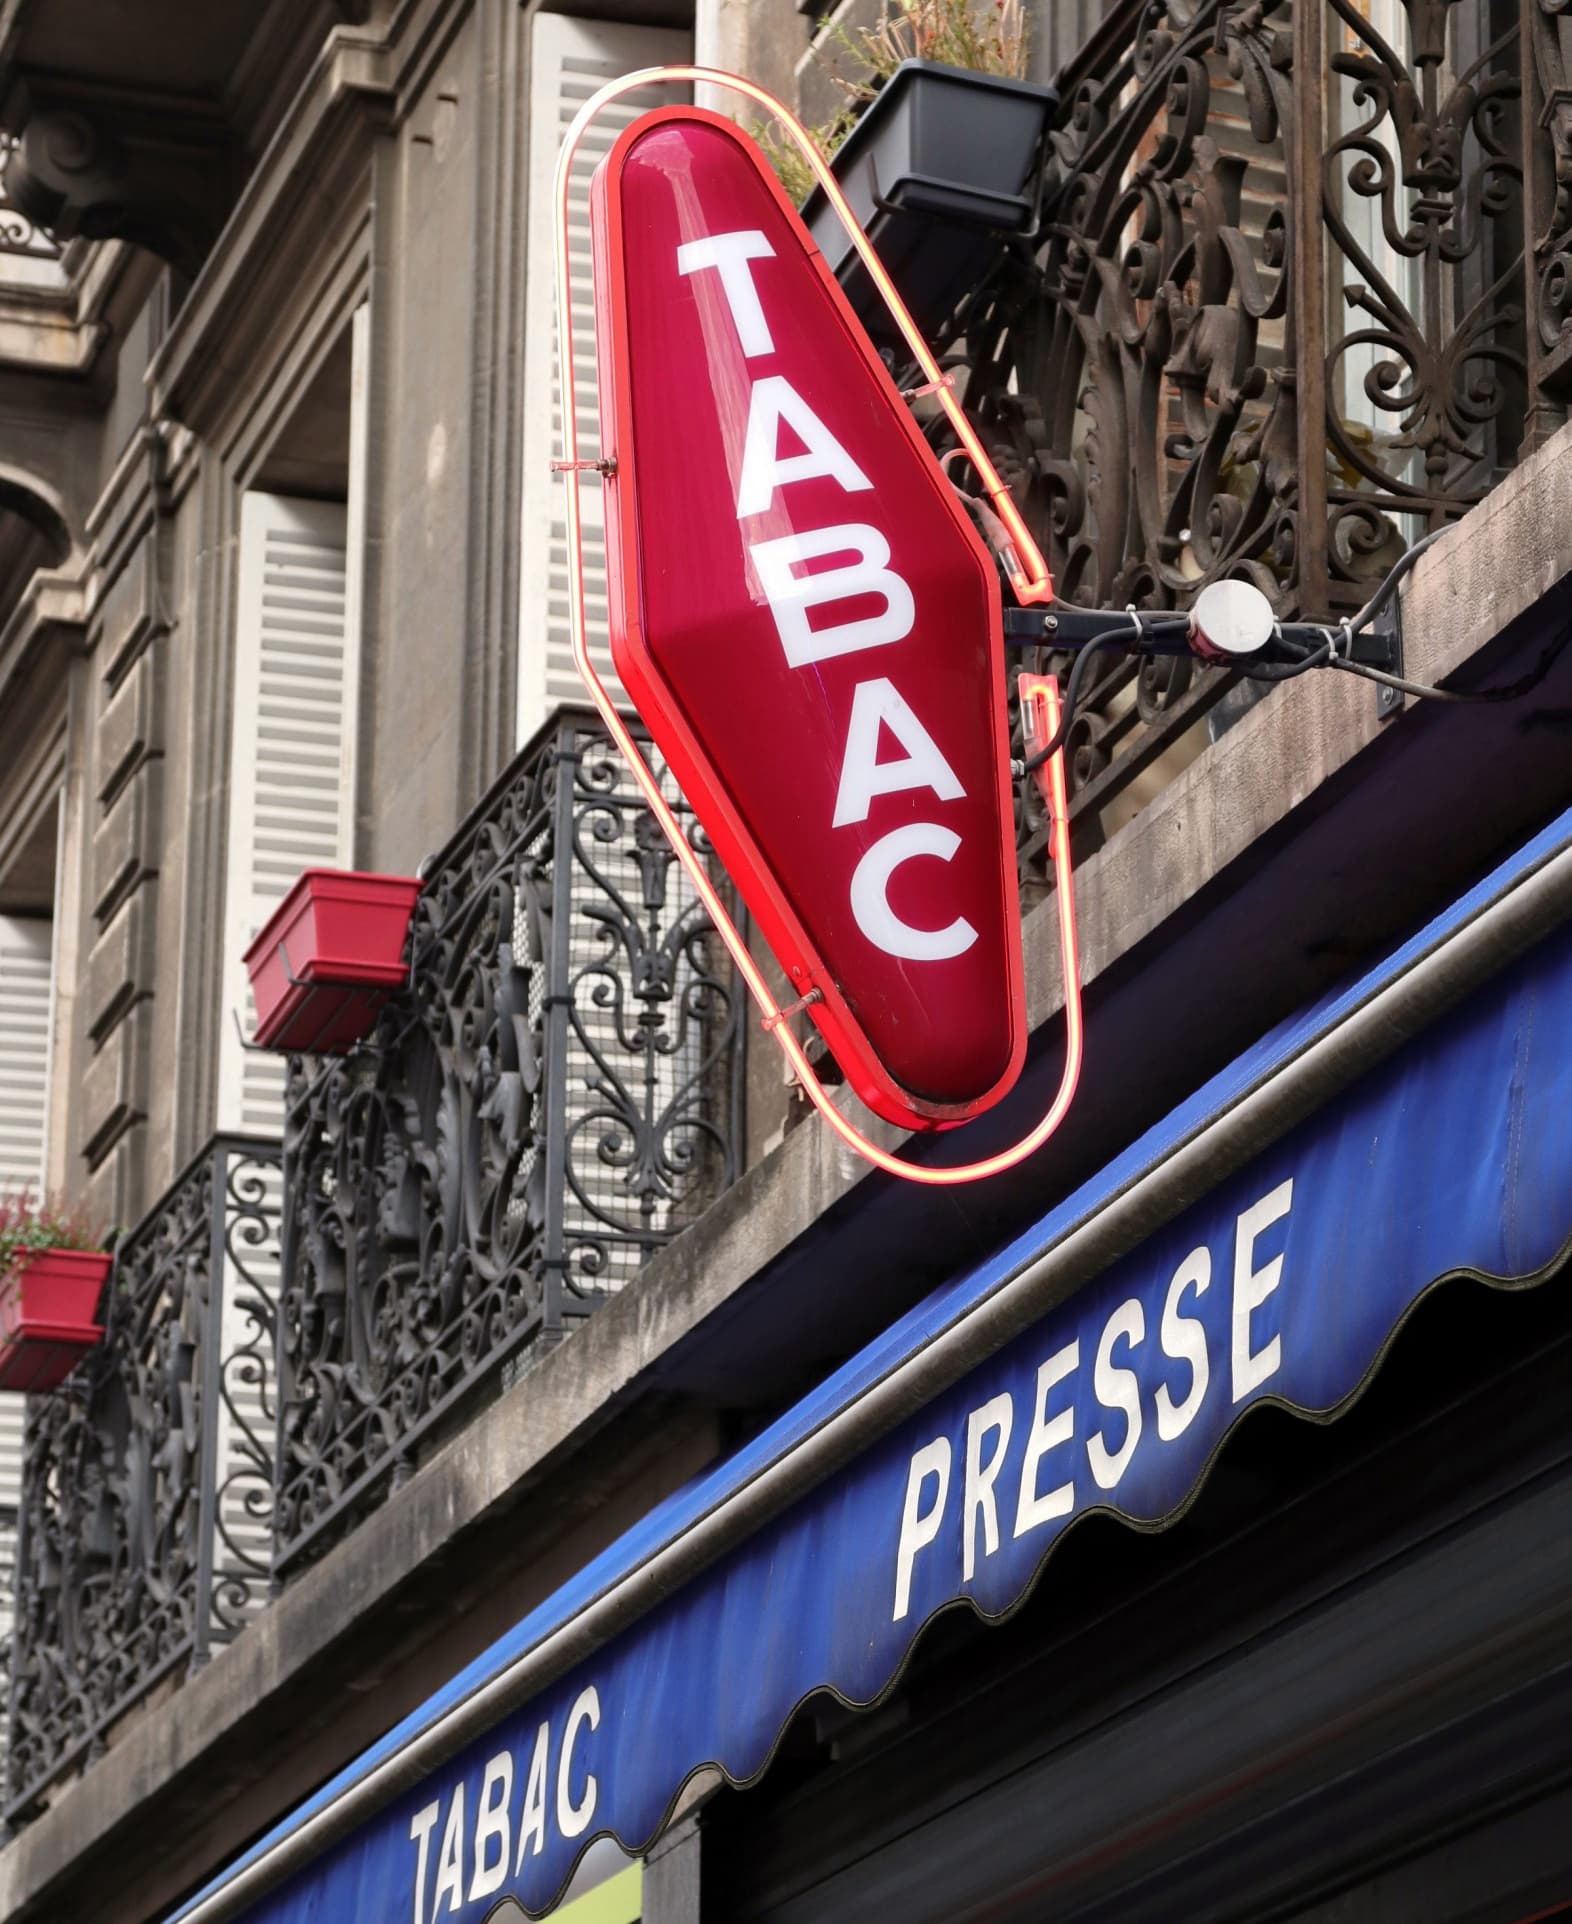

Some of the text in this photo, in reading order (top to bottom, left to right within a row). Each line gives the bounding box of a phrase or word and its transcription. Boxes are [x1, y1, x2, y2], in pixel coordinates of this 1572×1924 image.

[677, 230, 979, 961] TABAC
[893, 1178, 1294, 1622] PRESSE
[410, 1686, 601, 1924] TABAC
